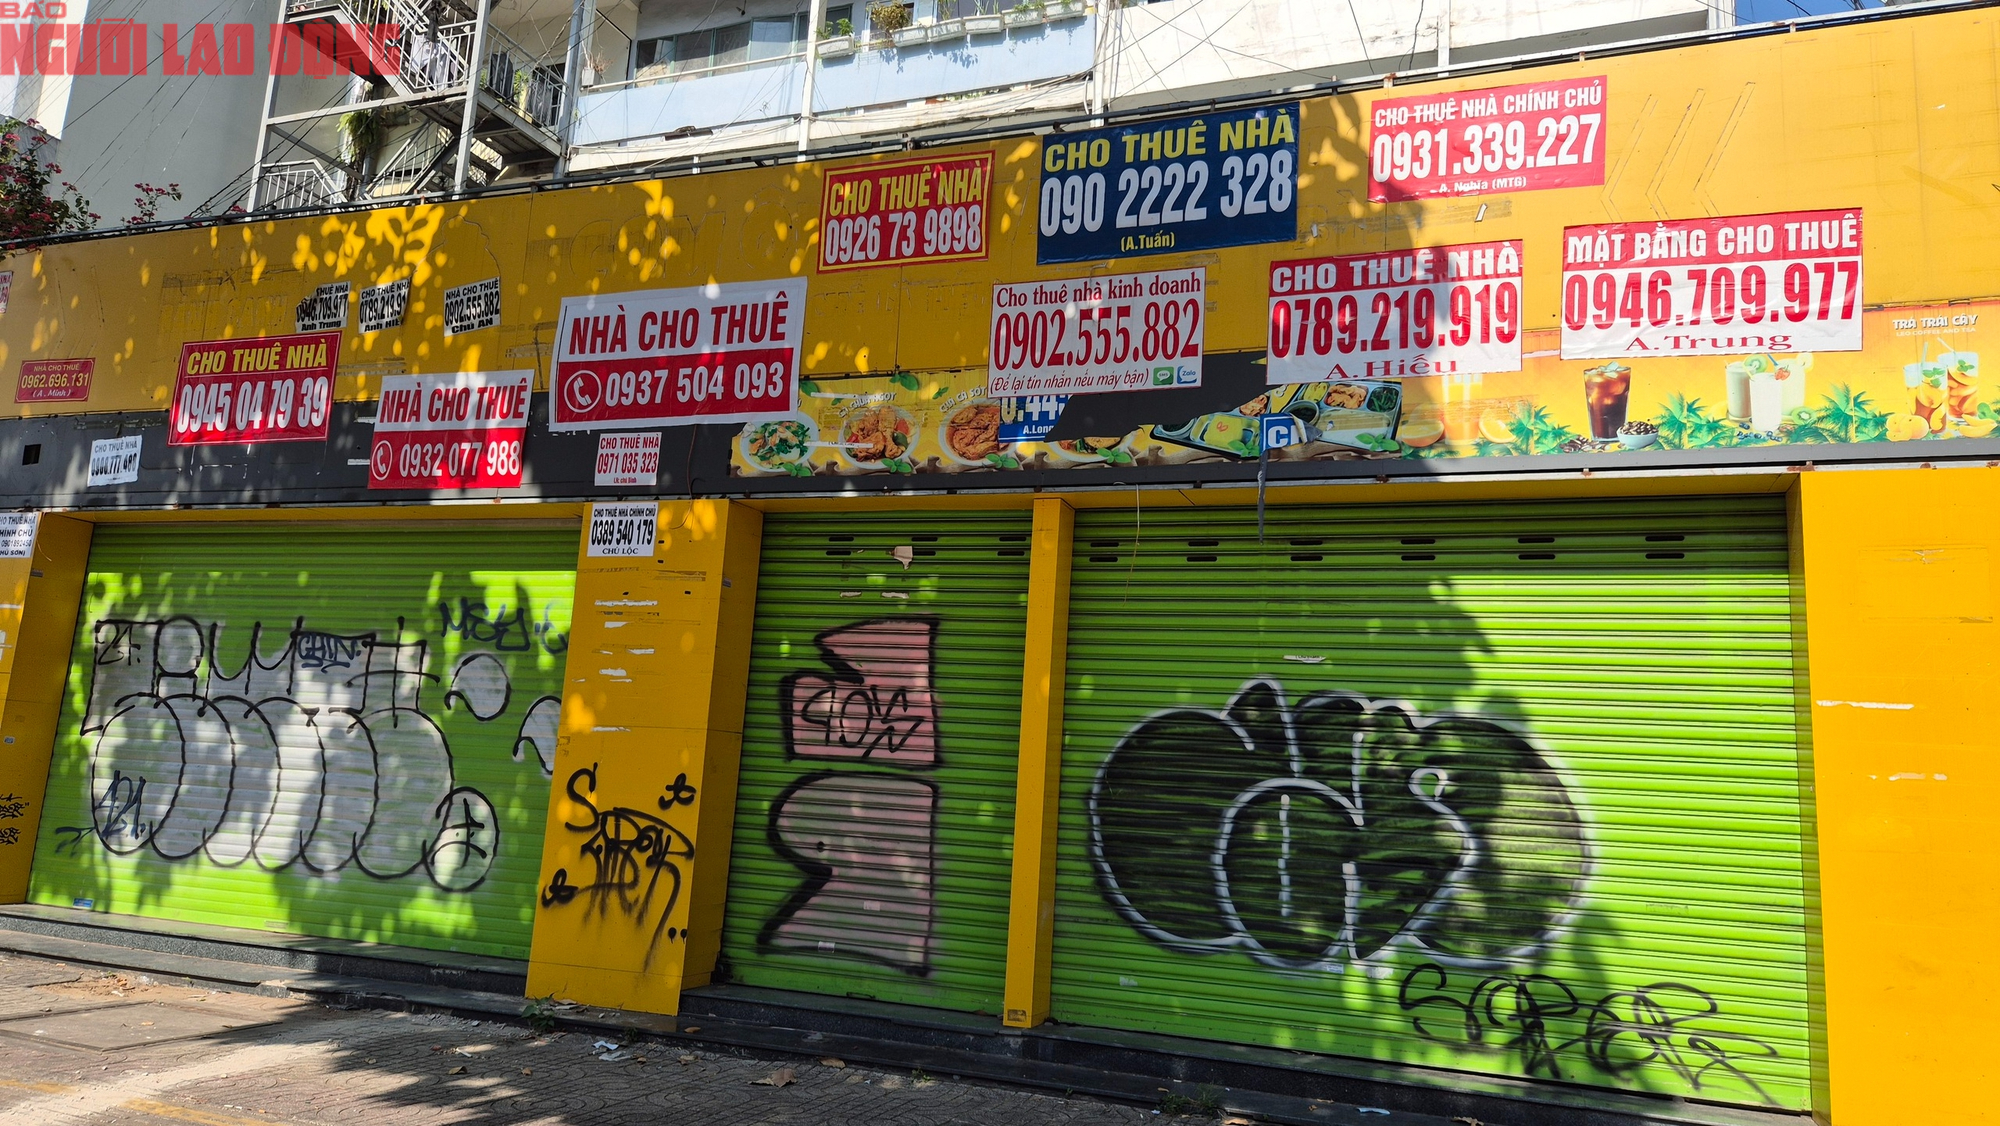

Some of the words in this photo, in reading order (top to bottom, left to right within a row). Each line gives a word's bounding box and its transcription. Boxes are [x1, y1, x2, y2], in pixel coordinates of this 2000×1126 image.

[1375, 108, 1408, 128] CHO
[1414, 97, 1456, 123] THUÊ
[1461, 93, 1498, 118] NHÀ
[1503, 89, 1559, 114] CHÍNH
[1564, 79, 1602, 107] CHỦ
[1044, 138, 1111, 173] CHO
[1121, 119, 1207, 164] THUÊ
[1219, 108, 1295, 152] NHÀ
[1372, 112, 1601, 183] 0931.339.227
[829, 179, 872, 217] CHO
[879, 165, 932, 211] THUÊ
[937, 160, 982, 205] NHÀ
[1040, 172, 1106, 238] 090
[1115, 160, 1209, 229] 2222
[1220, 149, 1293, 219] 328
[1492, 177, 1527, 189] (MTG)
[825, 214, 881, 264] 0926
[888, 210, 917, 258] 73
[923, 204, 981, 255] 9898
[1120, 229, 1176, 253] (A.Tuấn)
[1567, 230, 1625, 268] MẶT
[1630, 222, 1707, 261] BẰNG
[1717, 225, 1774, 256] CHO
[1784, 213, 1858, 251] THUÊ
[1272, 263, 1337, 293] CHO
[1349, 249, 1434, 287] THUÊ
[1448, 242, 1519, 278] NHÀ
[361, 289, 375, 299] CHO
[377, 284, 395, 295] THUÊ
[446, 289, 460, 301] NHÀ
[462, 285, 478, 296] CHO
[479, 279, 498, 293] THUÊ
[996, 286, 1028, 308] Cho
[1033, 284, 1068, 305] thuê
[1073, 281, 1103, 302] nhà
[1108, 276, 1143, 299] kinh
[1149, 271, 1201, 296] doanh
[1564, 260, 1859, 331] 0946.709.977
[360, 292, 406, 323] 0789.219.91
[445, 290, 499, 326] 0902.555.882
[478, 318, 493, 328] AN
[569, 304, 627, 355] NHÀ
[638, 307, 699, 352] CHO
[710, 290, 789, 345] THUÊ
[1271, 282, 1517, 359] 0789.219.919
[1921, 315, 1948, 328] TRÁI
[1952, 312, 1979, 326] CÂY
[301, 323, 316, 331] Anh
[319, 320, 341, 329] Trung
[364, 323, 382, 332] Anh
[994, 298, 1200, 371] 0902.555.882
[34, 364, 47, 372] NHÀ
[63, 363, 80, 371] THUÊ
[187, 350, 226, 375] CHO
[233, 342, 282, 372] THUÊ
[286, 339, 327, 368] NHÀ
[1324, 353, 1458, 380] A.Hiếu
[21, 372, 89, 389] 0962.696.131
[605, 369, 669, 407] 0937
[676, 365, 724, 403] 504
[734, 361, 784, 400] 093
[1011, 374, 1024, 394] lại
[1073, 368, 1093, 387] nếu
[1096, 371, 1122, 389] máy
[1123, 368, 1149, 388] bận)
[177, 383, 233, 433] 0945
[236, 381, 265, 431] 04
[268, 379, 295, 428] 79
[297, 376, 329, 428] 39
[380, 382, 422, 423] NHÀ
[428, 387, 470, 422] CHO
[475, 377, 528, 420] THUÊ
[95, 444, 107, 453] CHO
[109, 440, 124, 451] THUÊ
[600, 437, 617, 449] CHO
[620, 434, 640, 449] THUÊ
[642, 433, 659, 448] NHÀ
[400, 443, 444, 477] 0932
[449, 442, 483, 477] 077
[486, 440, 521, 476] 988
[597, 452, 619, 474] 0971
[621, 452, 639, 473] 035
[640, 452, 658, 473] 323
[594, 508, 604, 517] CHO
[0, 527, 16, 537] HÍNH
[591, 519, 615, 545] 0389
[616, 519, 634, 545] 540
[637, 519, 654, 545] 179
